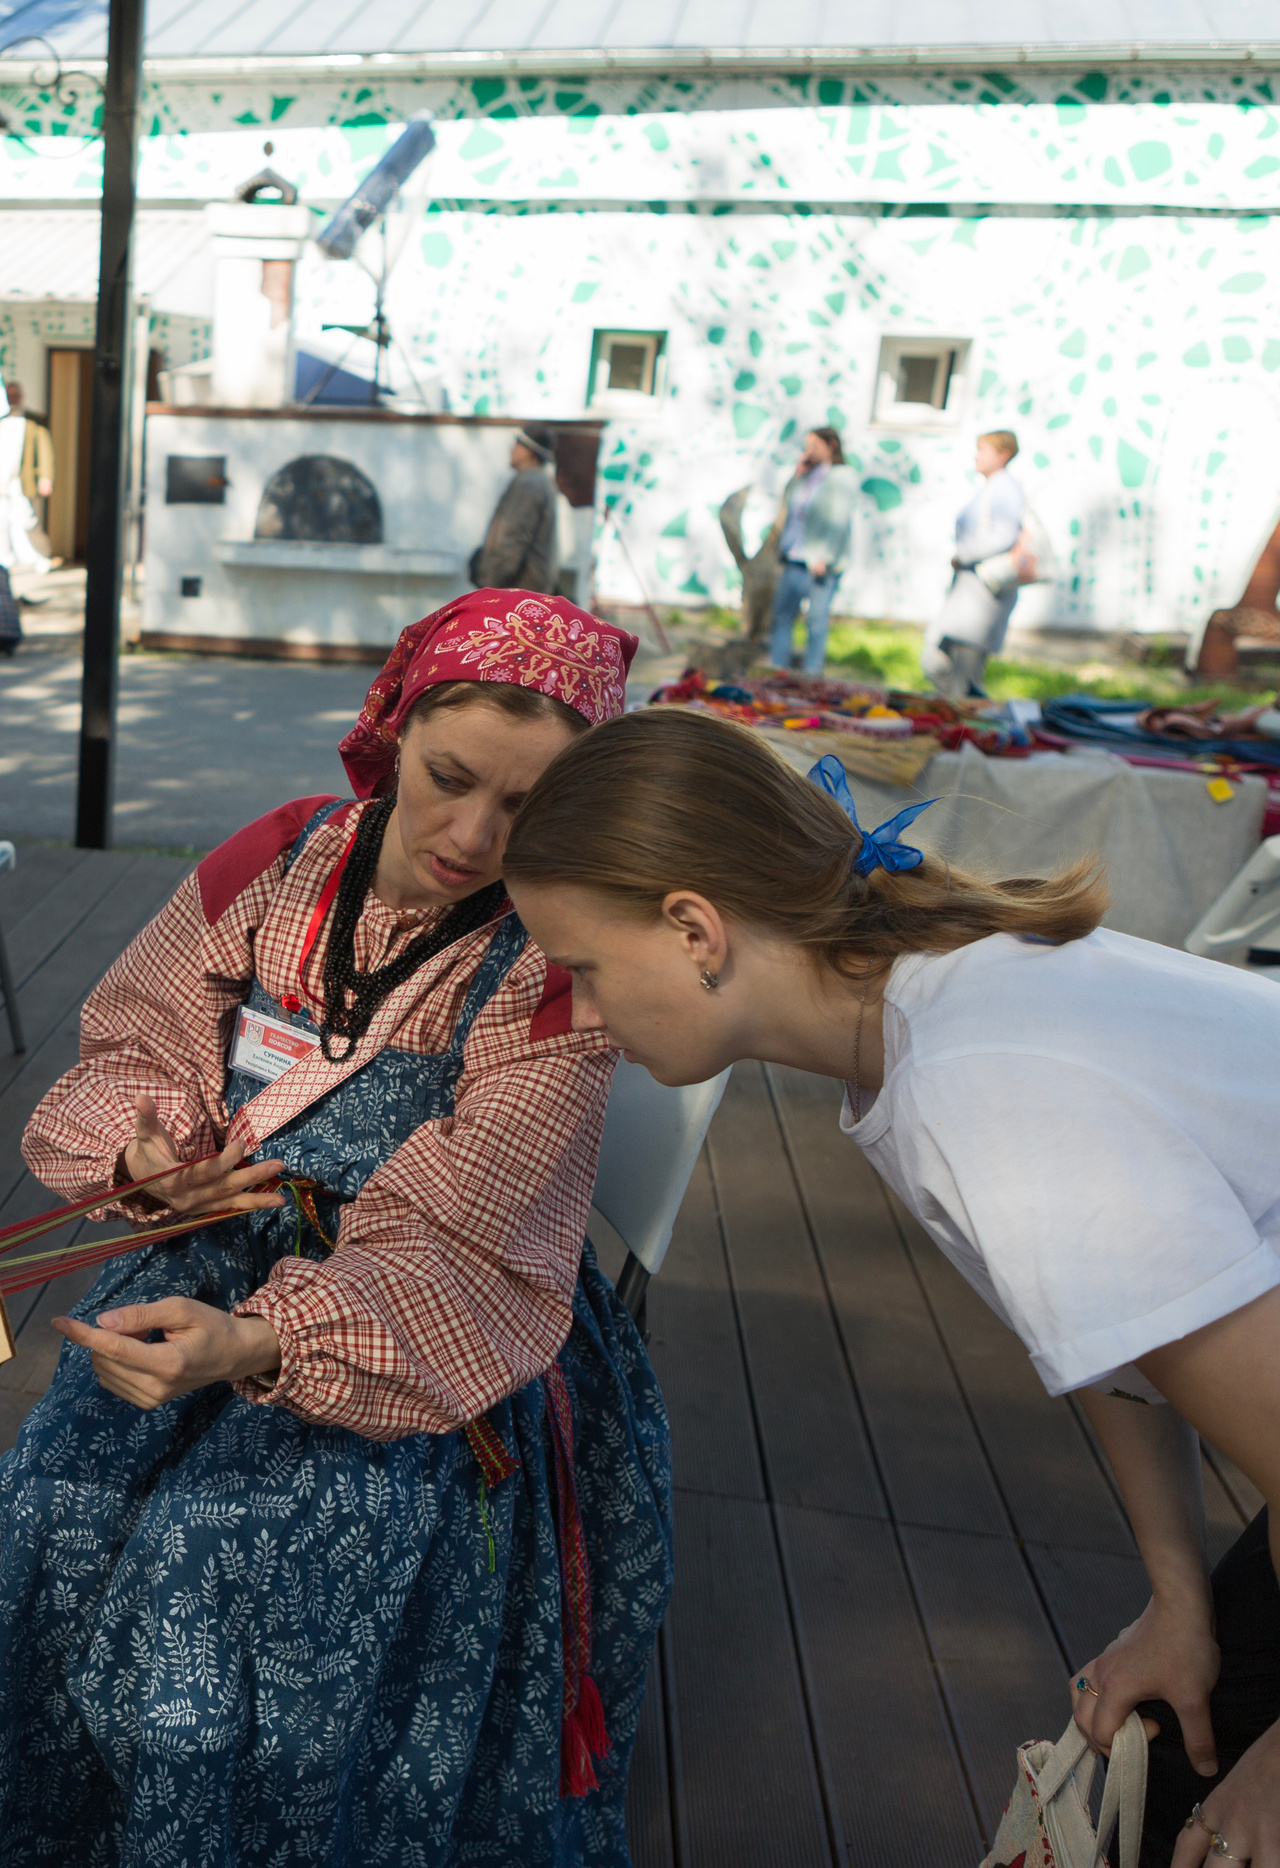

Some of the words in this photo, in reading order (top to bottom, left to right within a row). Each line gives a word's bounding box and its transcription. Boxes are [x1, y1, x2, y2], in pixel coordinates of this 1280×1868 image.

[268, 1038, 292, 1052] ПОЯСОВ
[270, 1033, 299, 1047] ТКАЧЕСТВО
[263, 1051, 291, 1066] СУРНИНА
